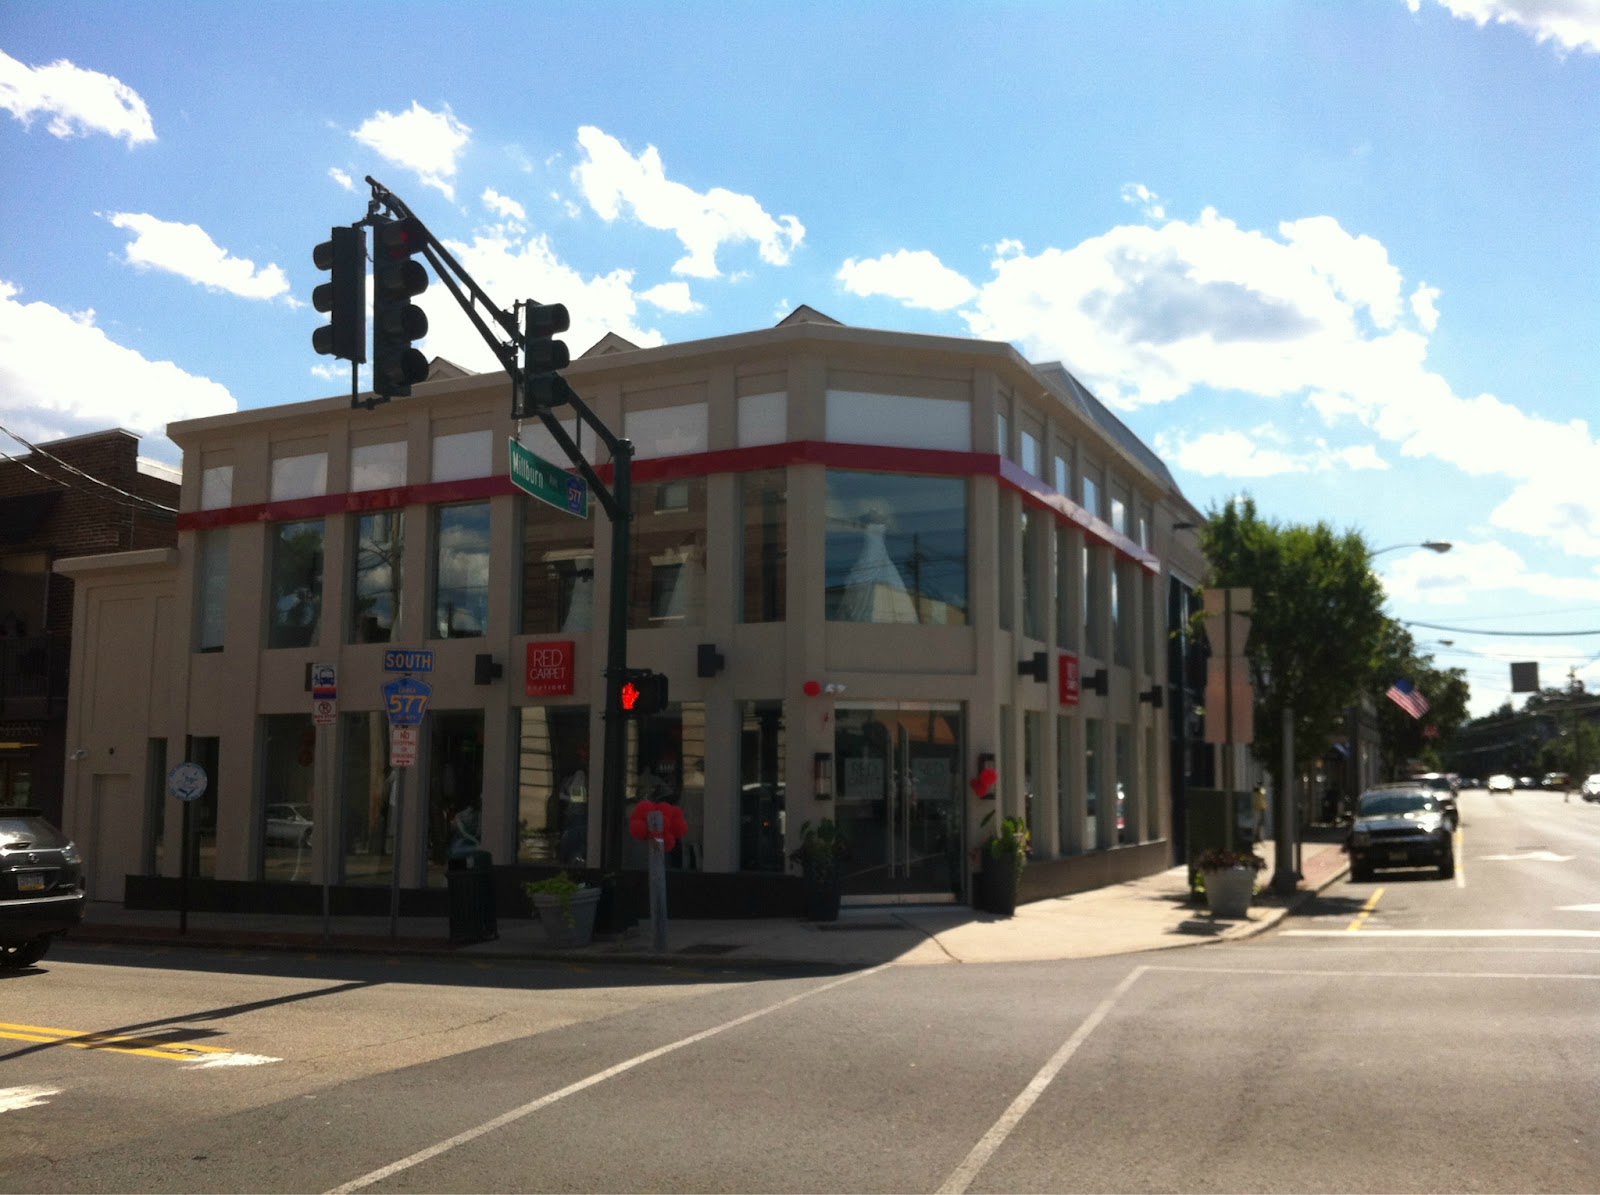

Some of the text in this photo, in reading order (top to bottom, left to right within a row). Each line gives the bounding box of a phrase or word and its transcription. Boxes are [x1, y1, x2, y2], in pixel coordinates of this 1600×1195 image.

[513, 451, 544, 489] Millburn
[568, 487, 582, 504] 577
[386, 654, 431, 669] SOUTH
[533, 649, 563, 668] RED
[530, 667, 566, 680] CARPET
[390, 694, 428, 713] 577
[400, 731, 409, 739] NO
